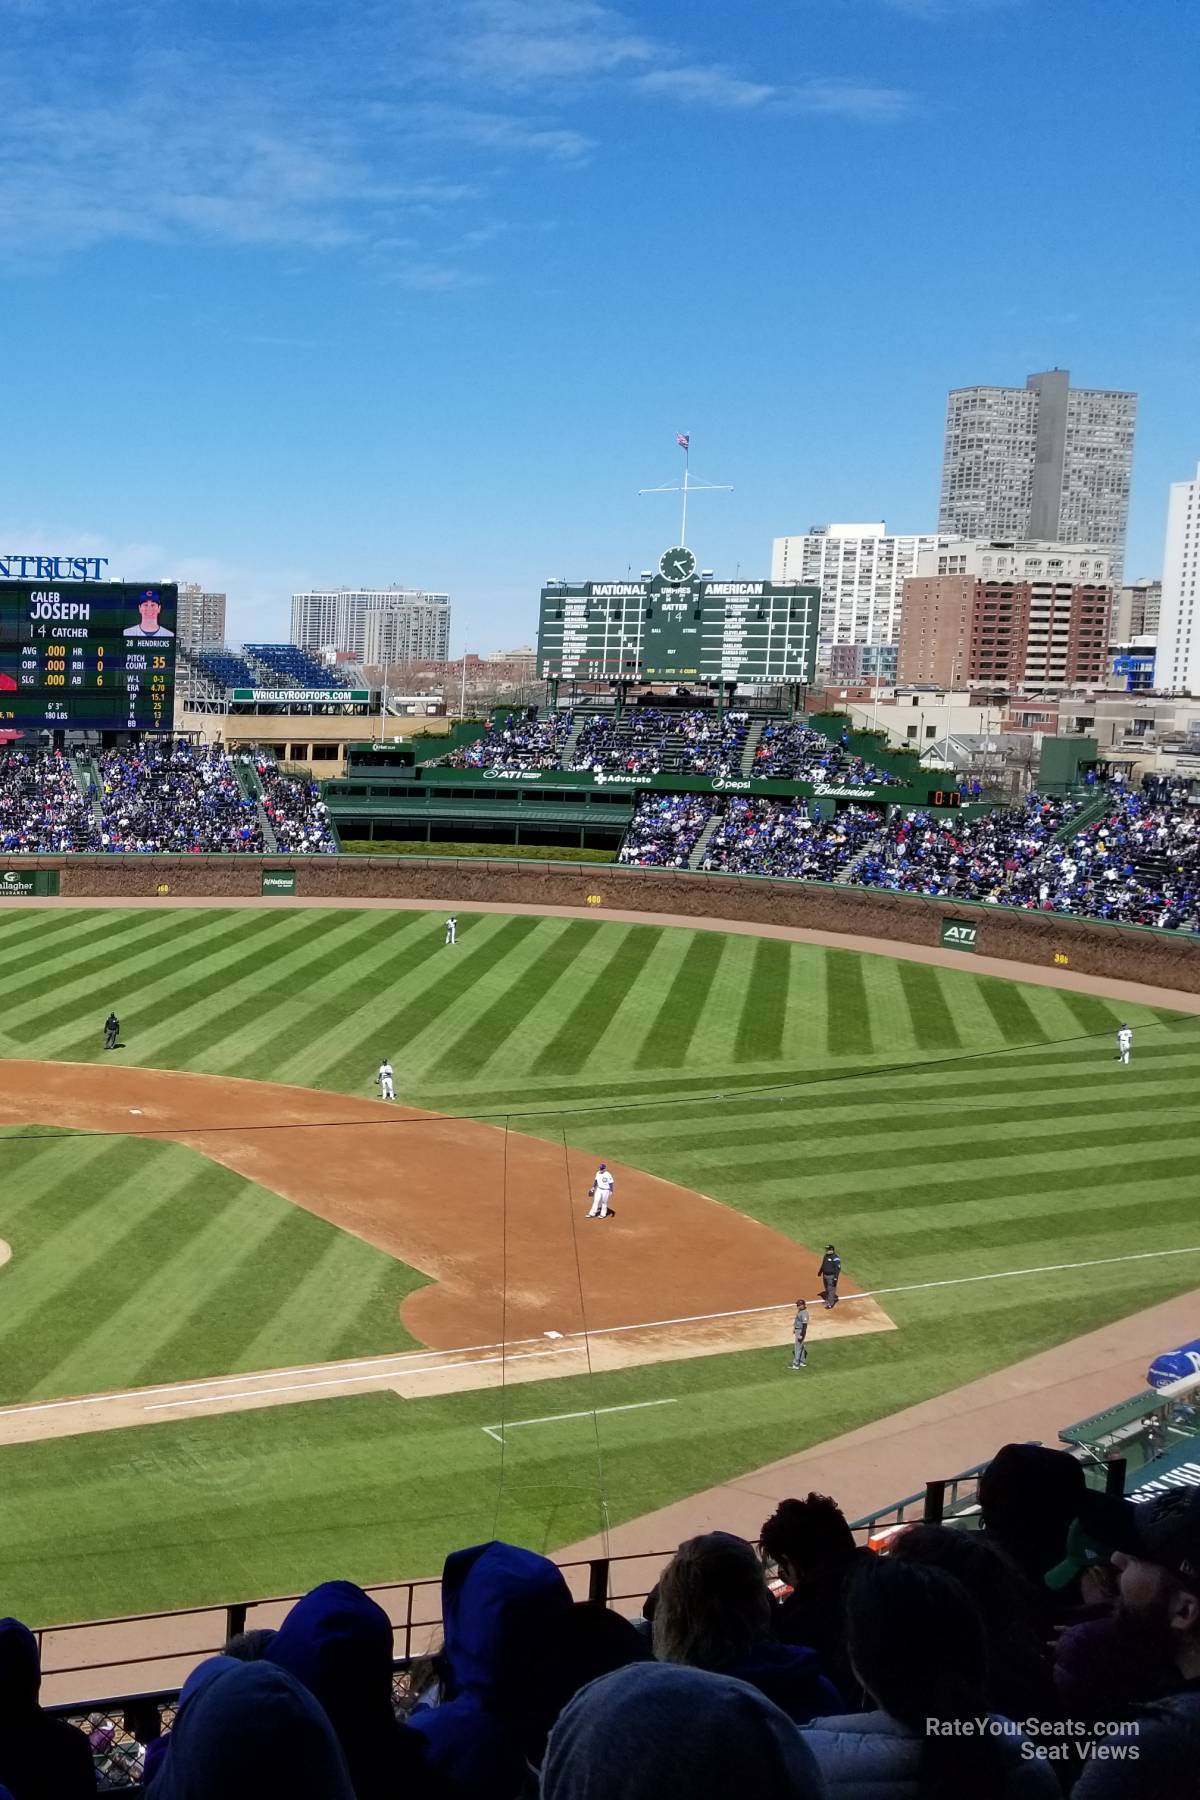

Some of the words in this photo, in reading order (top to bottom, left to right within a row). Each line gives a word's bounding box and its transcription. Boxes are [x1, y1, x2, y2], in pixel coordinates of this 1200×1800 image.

[592, 584, 647, 595] NATIONAL
[705, 584, 763, 595] AMERICAN
[30, 592, 60, 603] CALEB
[30, 603, 90, 620] JOSEPH
[662, 603, 688, 611] BATTER
[51, 628, 88, 638] CATCHER
[22, 647, 37, 655] AVG
[45, 646, 65, 656] .000
[72, 648, 82, 656] HR
[97, 646, 104, 657] 0
[127, 654, 145, 662] PITCH
[152, 656, 166, 669] 35
[22, 661, 37, 669] OBP
[44, 660, 65, 671] .000
[72, 662, 84, 670] RBI
[97, 661, 103, 671] 0
[125, 662, 147, 670] COUNT
[21, 675, 34, 684] SLG
[44, 674, 65, 685] .000
[72, 676, 82, 684] AB
[97, 676, 103, 686] 6
[127, 684, 139, 692] ERA
[151, 684, 165, 692] 4.70
[130, 693, 137, 701] IP
[253, 690, 351, 701] WRIGLEYROOFTOPS.COM
[153, 702, 162, 710] 25
[45, 711, 56, 719] 180
[57, 711, 68, 719] LBS
[498, 771, 522, 779] ATI
[725, 780, 751, 790] pepsi
[813, 783, 876, 798] Budweiser
[935, 791, 961, 805] 0:17
[944, 926, 977, 940] ATI
